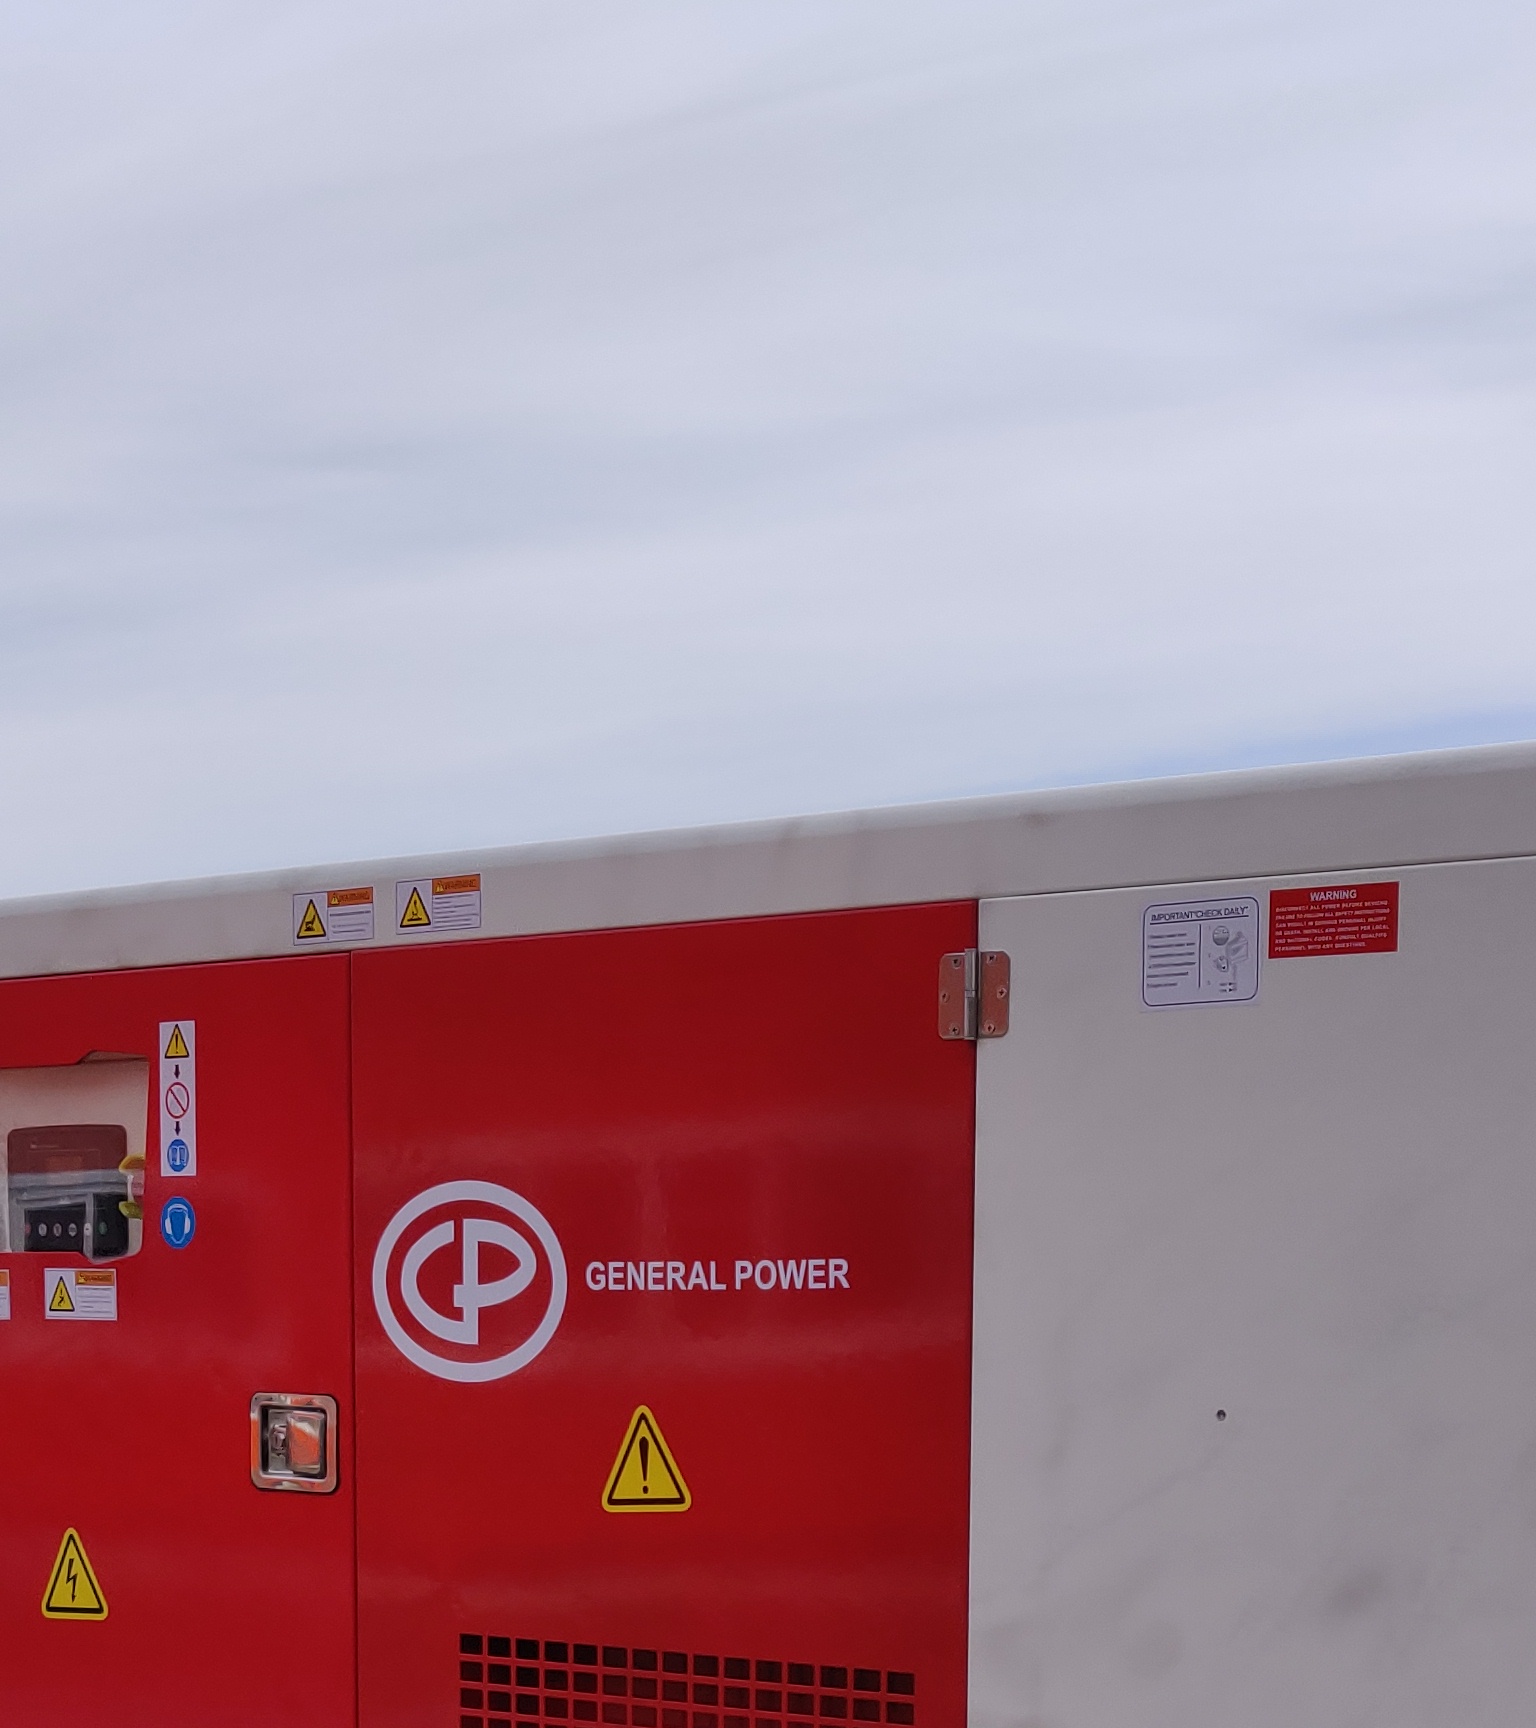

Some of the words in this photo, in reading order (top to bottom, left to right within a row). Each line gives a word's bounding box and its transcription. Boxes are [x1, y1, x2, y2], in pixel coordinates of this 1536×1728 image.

[1310, 890, 1357, 901] WARNING
[585, 1261, 727, 1291] GENERAL
[734, 1258, 851, 1290] POWER
